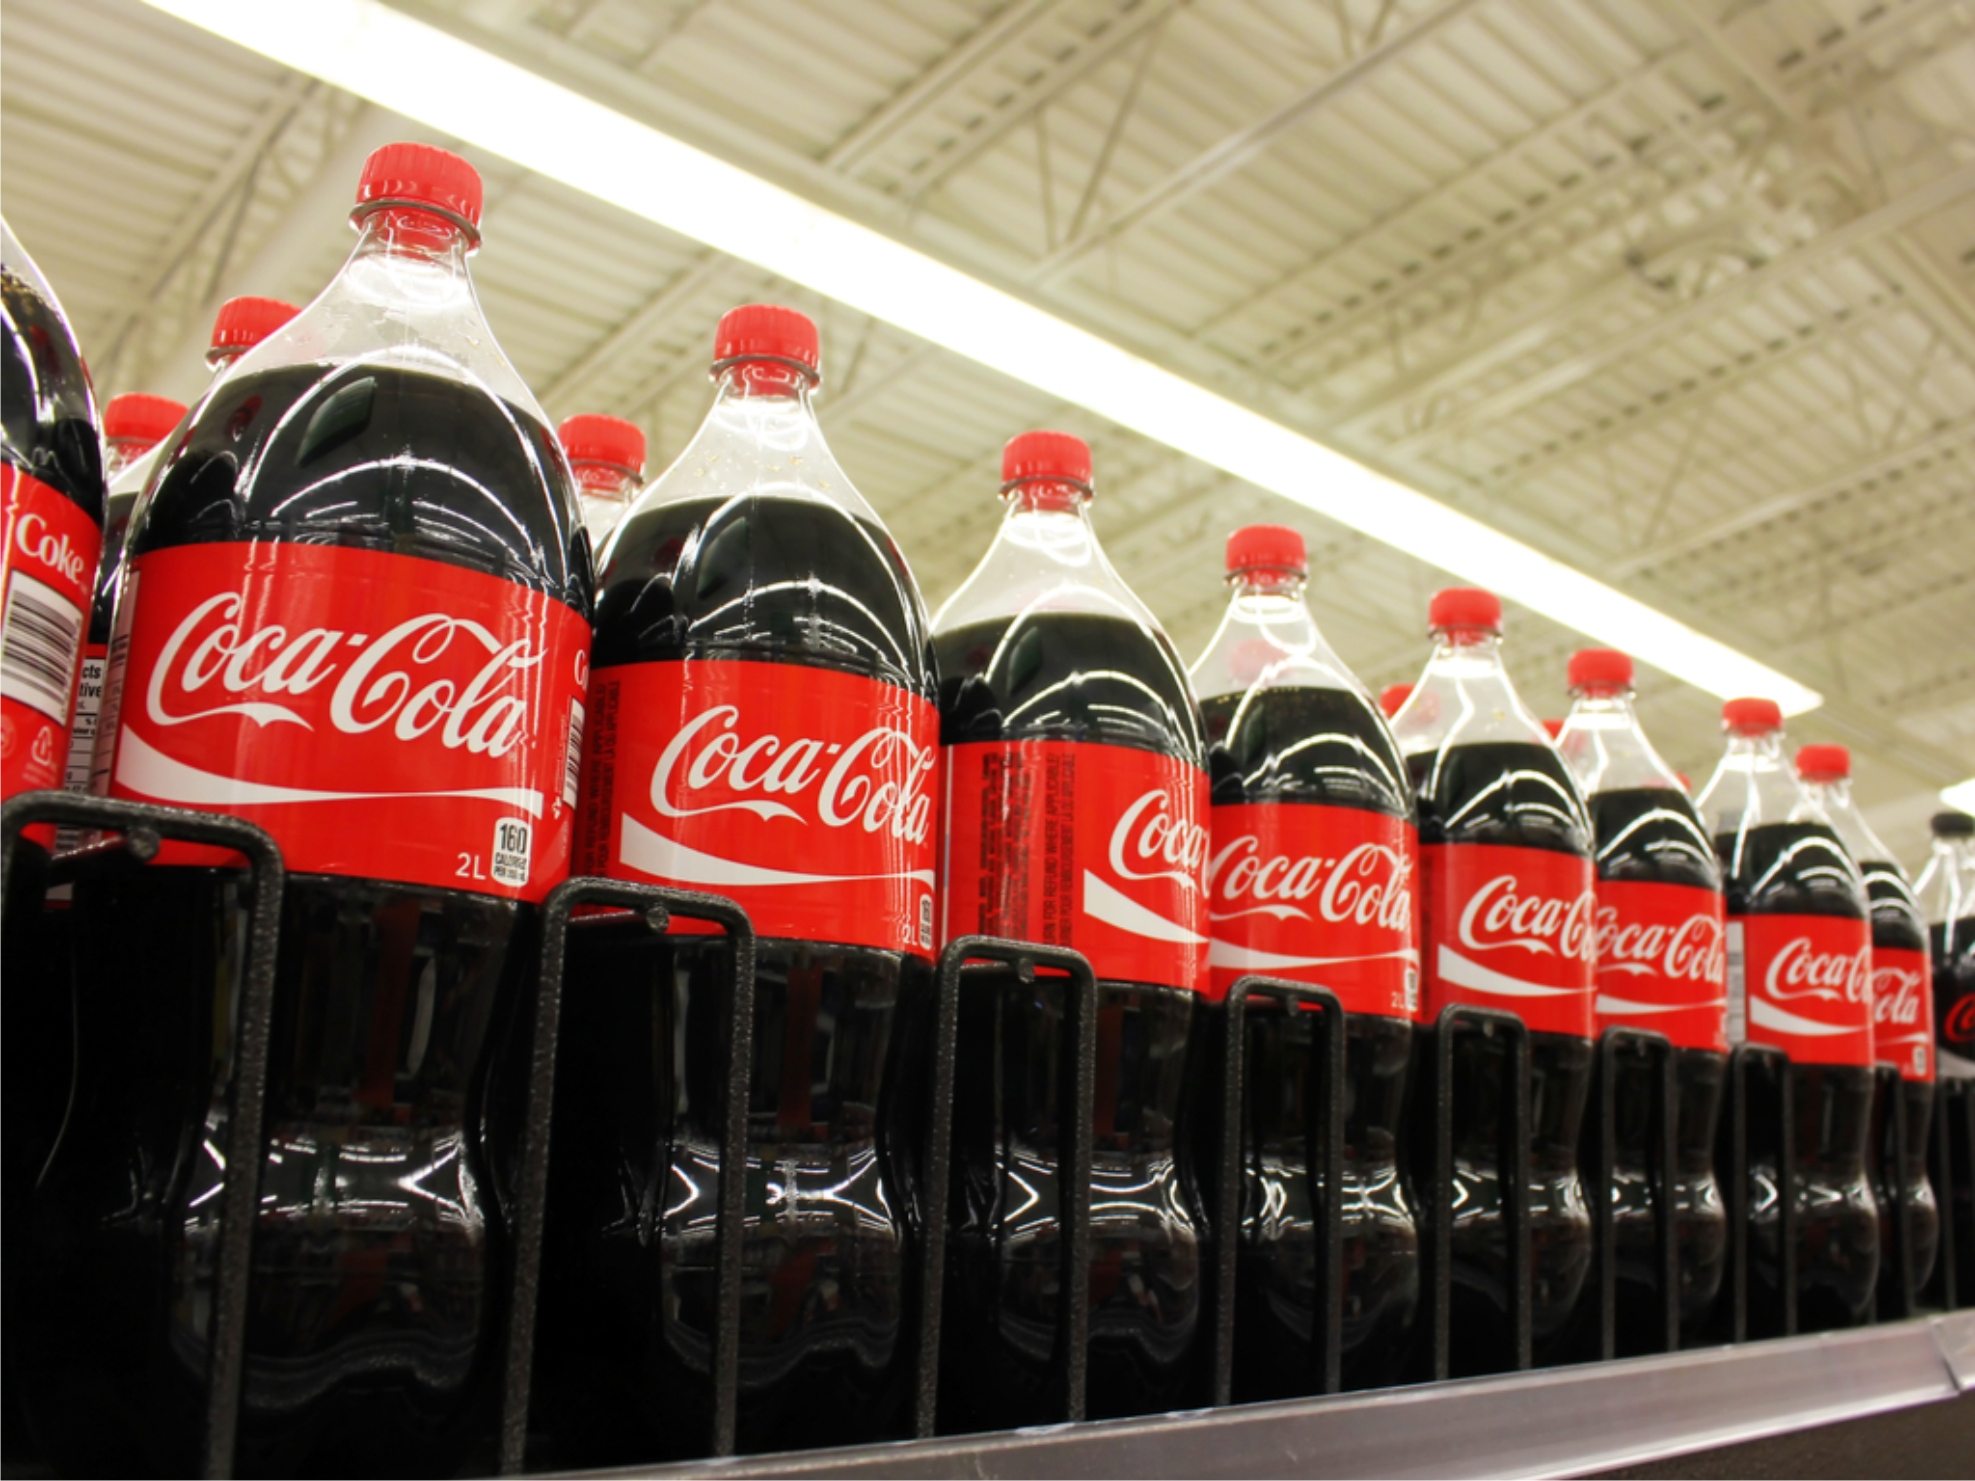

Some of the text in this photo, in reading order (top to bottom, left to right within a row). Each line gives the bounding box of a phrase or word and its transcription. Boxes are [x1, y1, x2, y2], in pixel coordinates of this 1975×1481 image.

[15, 512, 85, 585] Coke
[146, 591, 548, 758] Coca-Cola
[650, 704, 936, 846] Coca-Cola
[499, 823, 528, 854] 160
[1045, 819, 1058, 853] WHERE
[455, 852, 487, 880] 2L
[1044, 857, 1058, 898] REFUND
